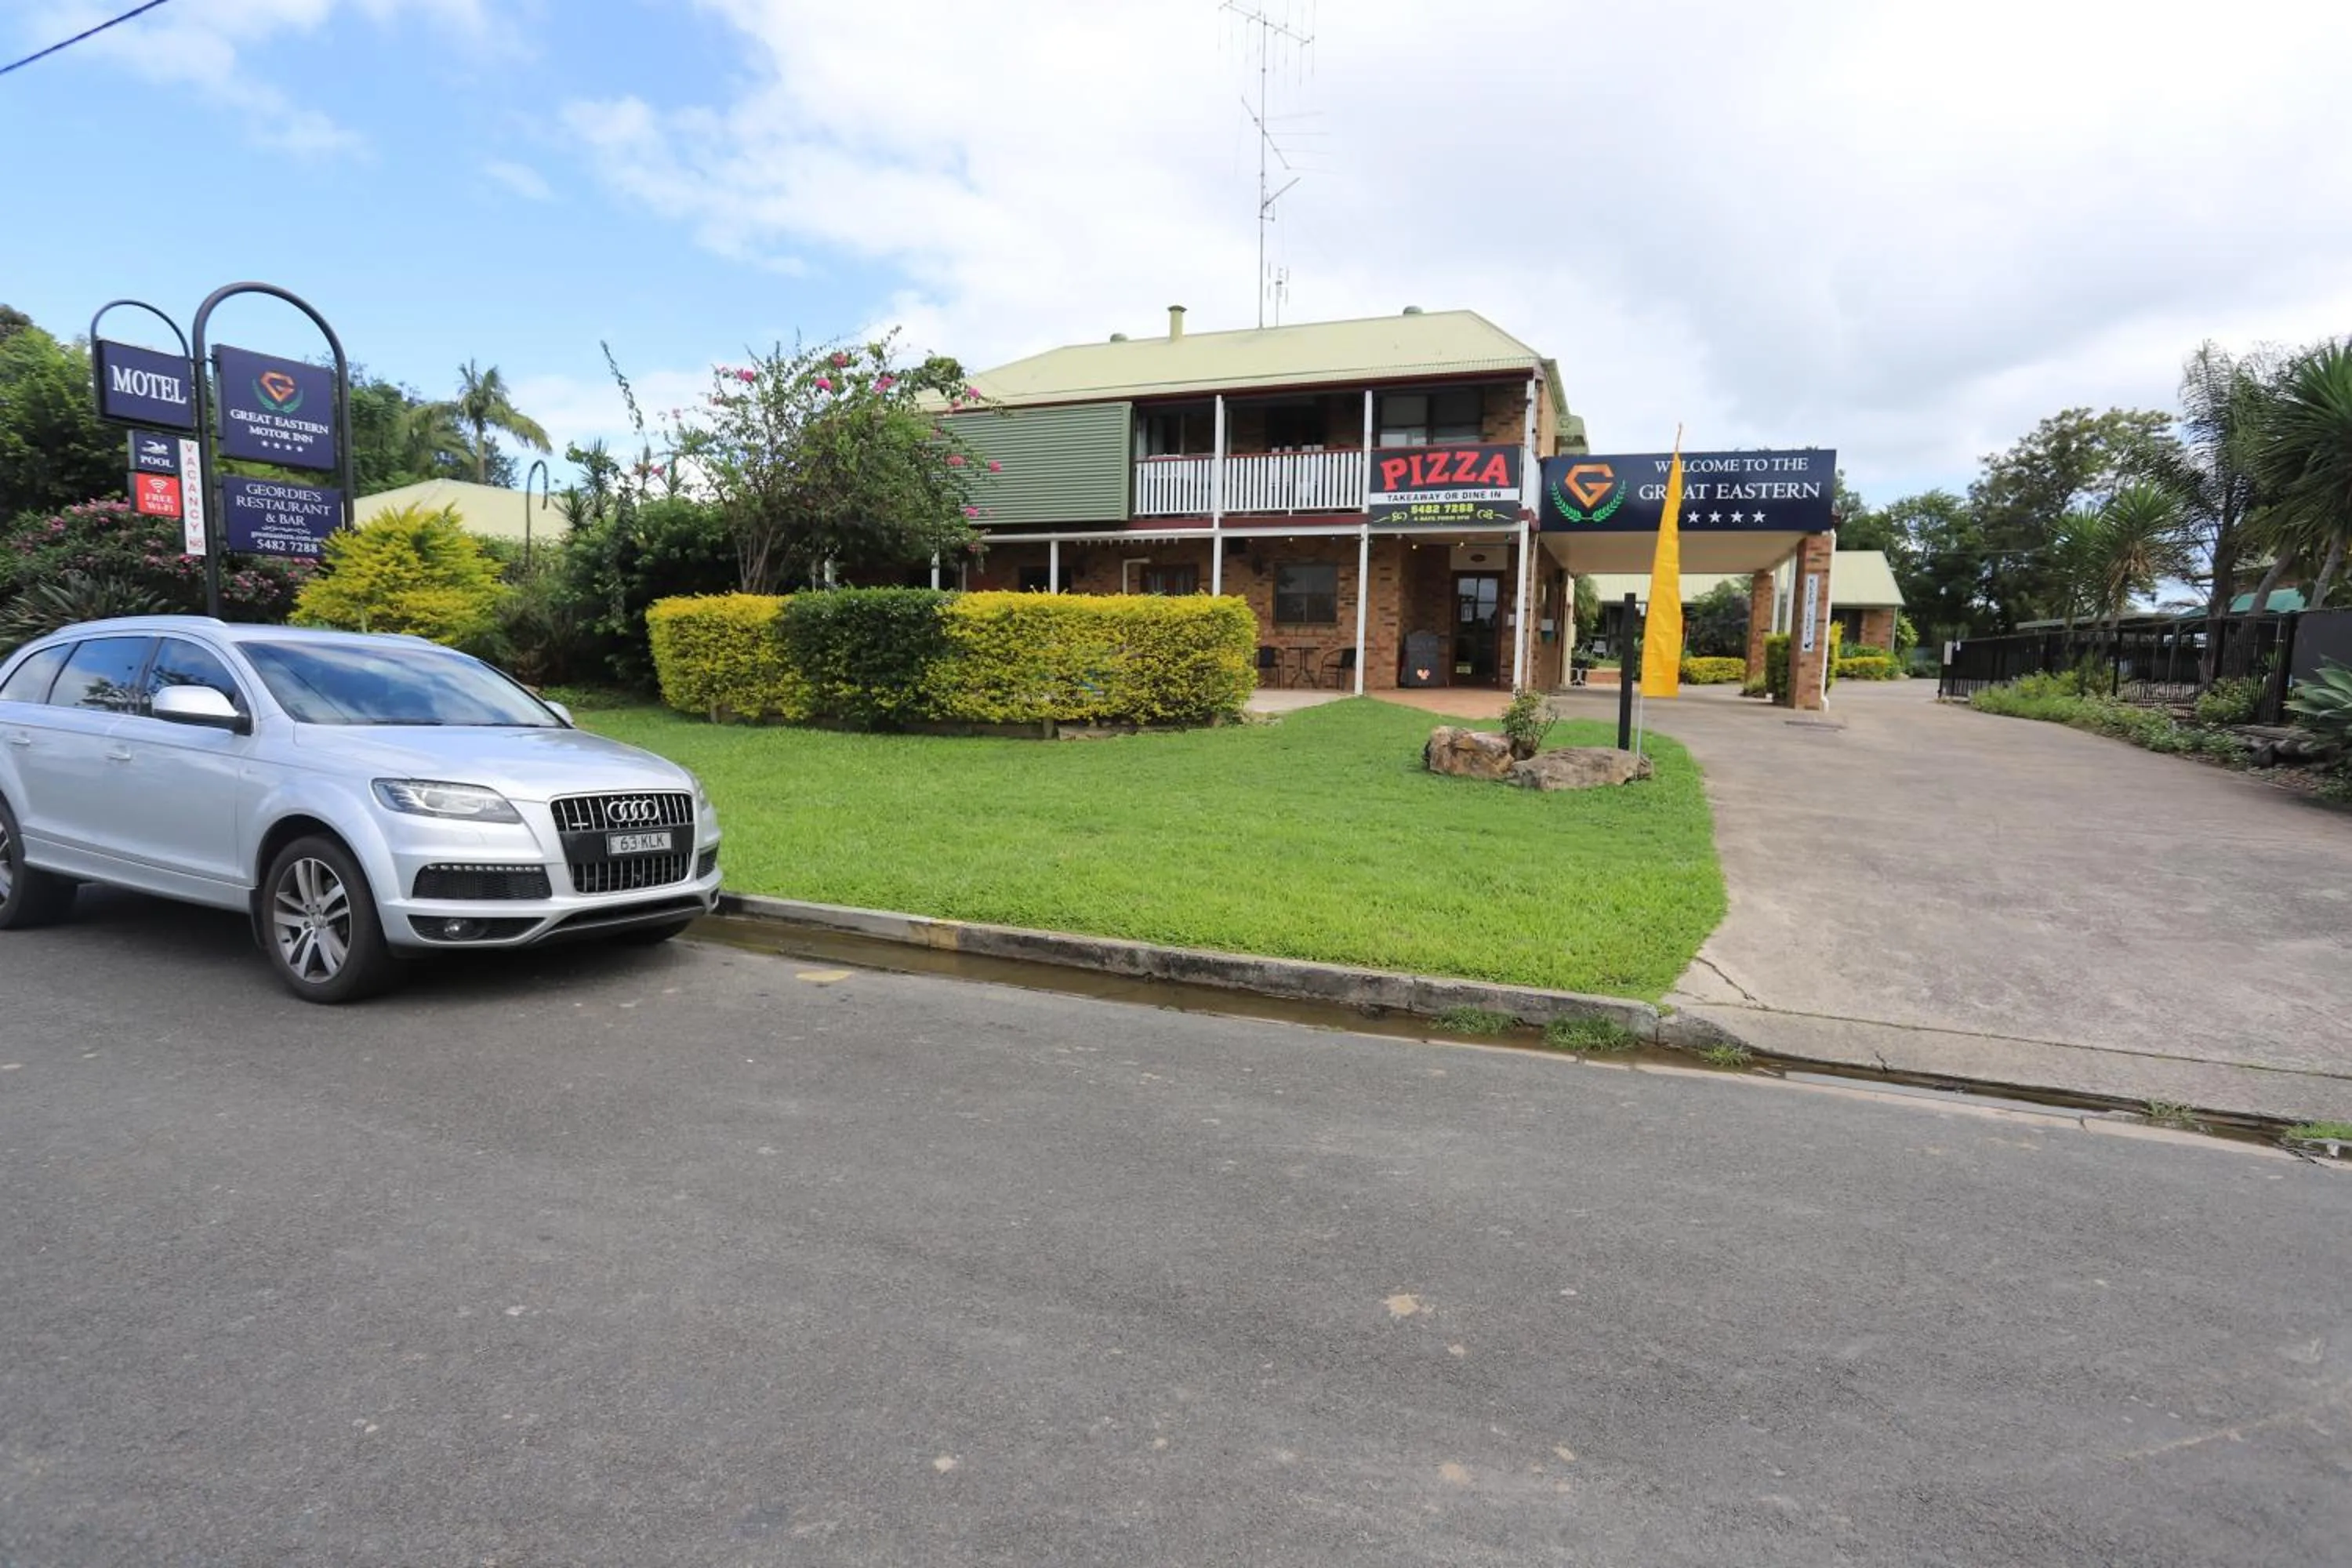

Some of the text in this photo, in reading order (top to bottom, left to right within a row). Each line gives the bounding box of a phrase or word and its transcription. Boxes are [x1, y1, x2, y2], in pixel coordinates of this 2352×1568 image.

[110, 365, 187, 404] MOTEL
[230, 408, 328, 434] GREAT EASTERN
[249, 425, 314, 445] MOTOR INN
[140, 456, 174, 468] POOL
[1655, 458, 1809, 473] WLCOME TO THE
[1380, 452, 1510, 491] PIZZA
[186, 443, 198, 532] VACANCY
[245, 483, 322, 503] GEORDIE'S
[1639, 482, 1821, 501] GRAT EASTERN
[144, 492, 173, 503] FREE
[236, 495, 332, 516] RESTAURANT
[1387, 493, 1441, 503] TAKEAWAY
[1462, 491, 1487, 500] DINE
[1411, 503, 1474, 514] 5482 7288
[265, 513, 307, 526] & BAR
[256, 539, 318, 553] 5482 7288
[620, 833, 666, 851] 63 KLK
